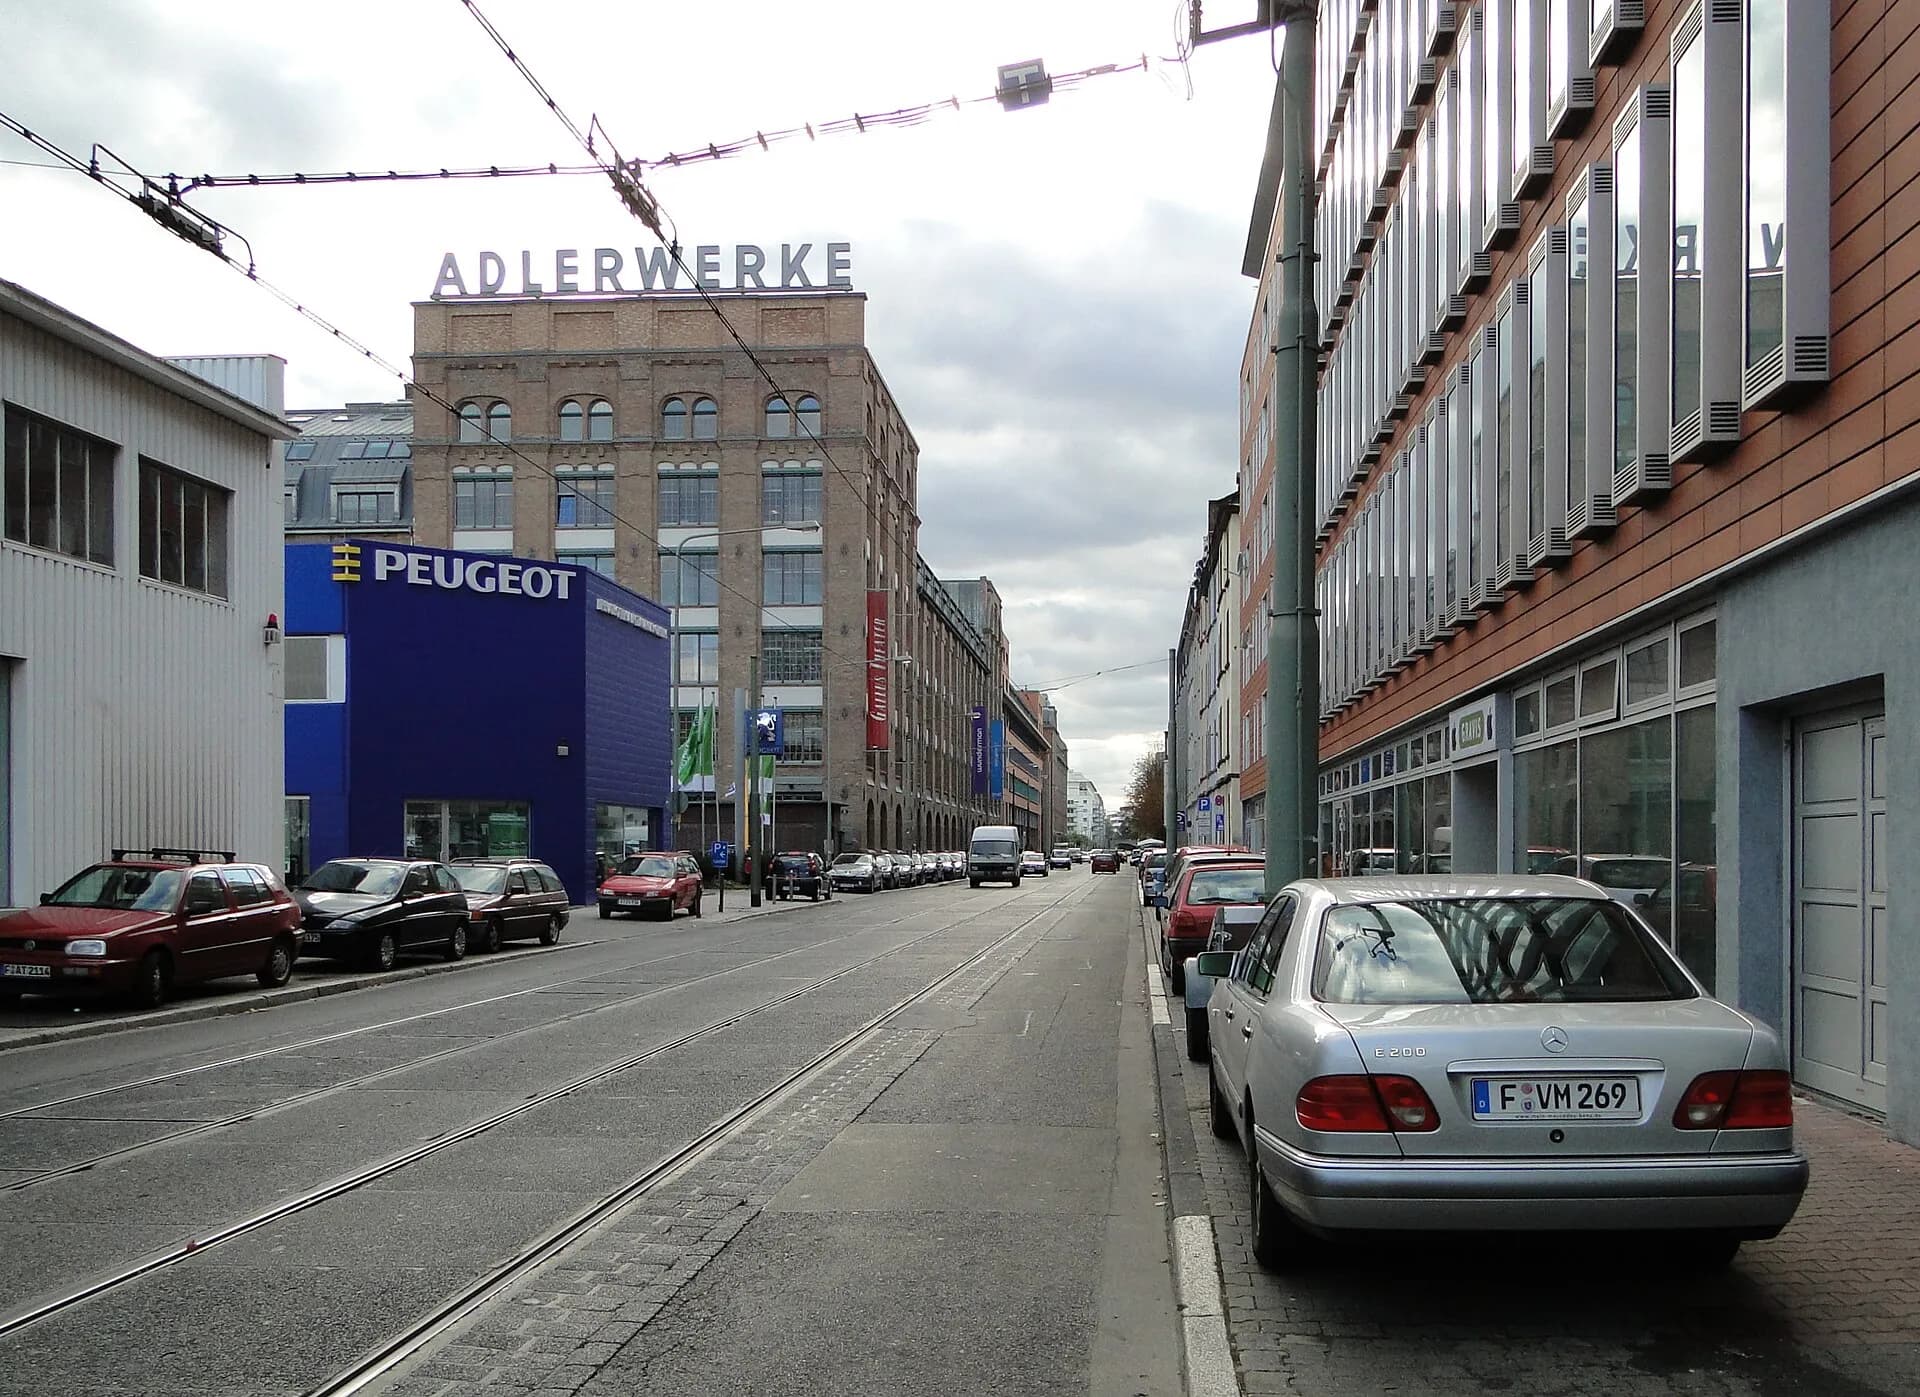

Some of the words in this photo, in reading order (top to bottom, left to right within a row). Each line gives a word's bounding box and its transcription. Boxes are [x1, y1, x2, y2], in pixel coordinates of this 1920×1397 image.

[432, 242, 851, 295] ADLERWERKE
[375, 549, 577, 599] PEUGEOT
[1200, 799, 1208, 810] P
[714, 843, 721, 853] P
[1375, 1048, 1385, 1057] E
[1390, 1047, 1426, 1057] 200
[1479, 1100, 1486, 1108] D
[1501, 1084, 1517, 1110] F
[1536, 1083, 1571, 1110] VM
[1577, 1082, 1627, 1109] 269
